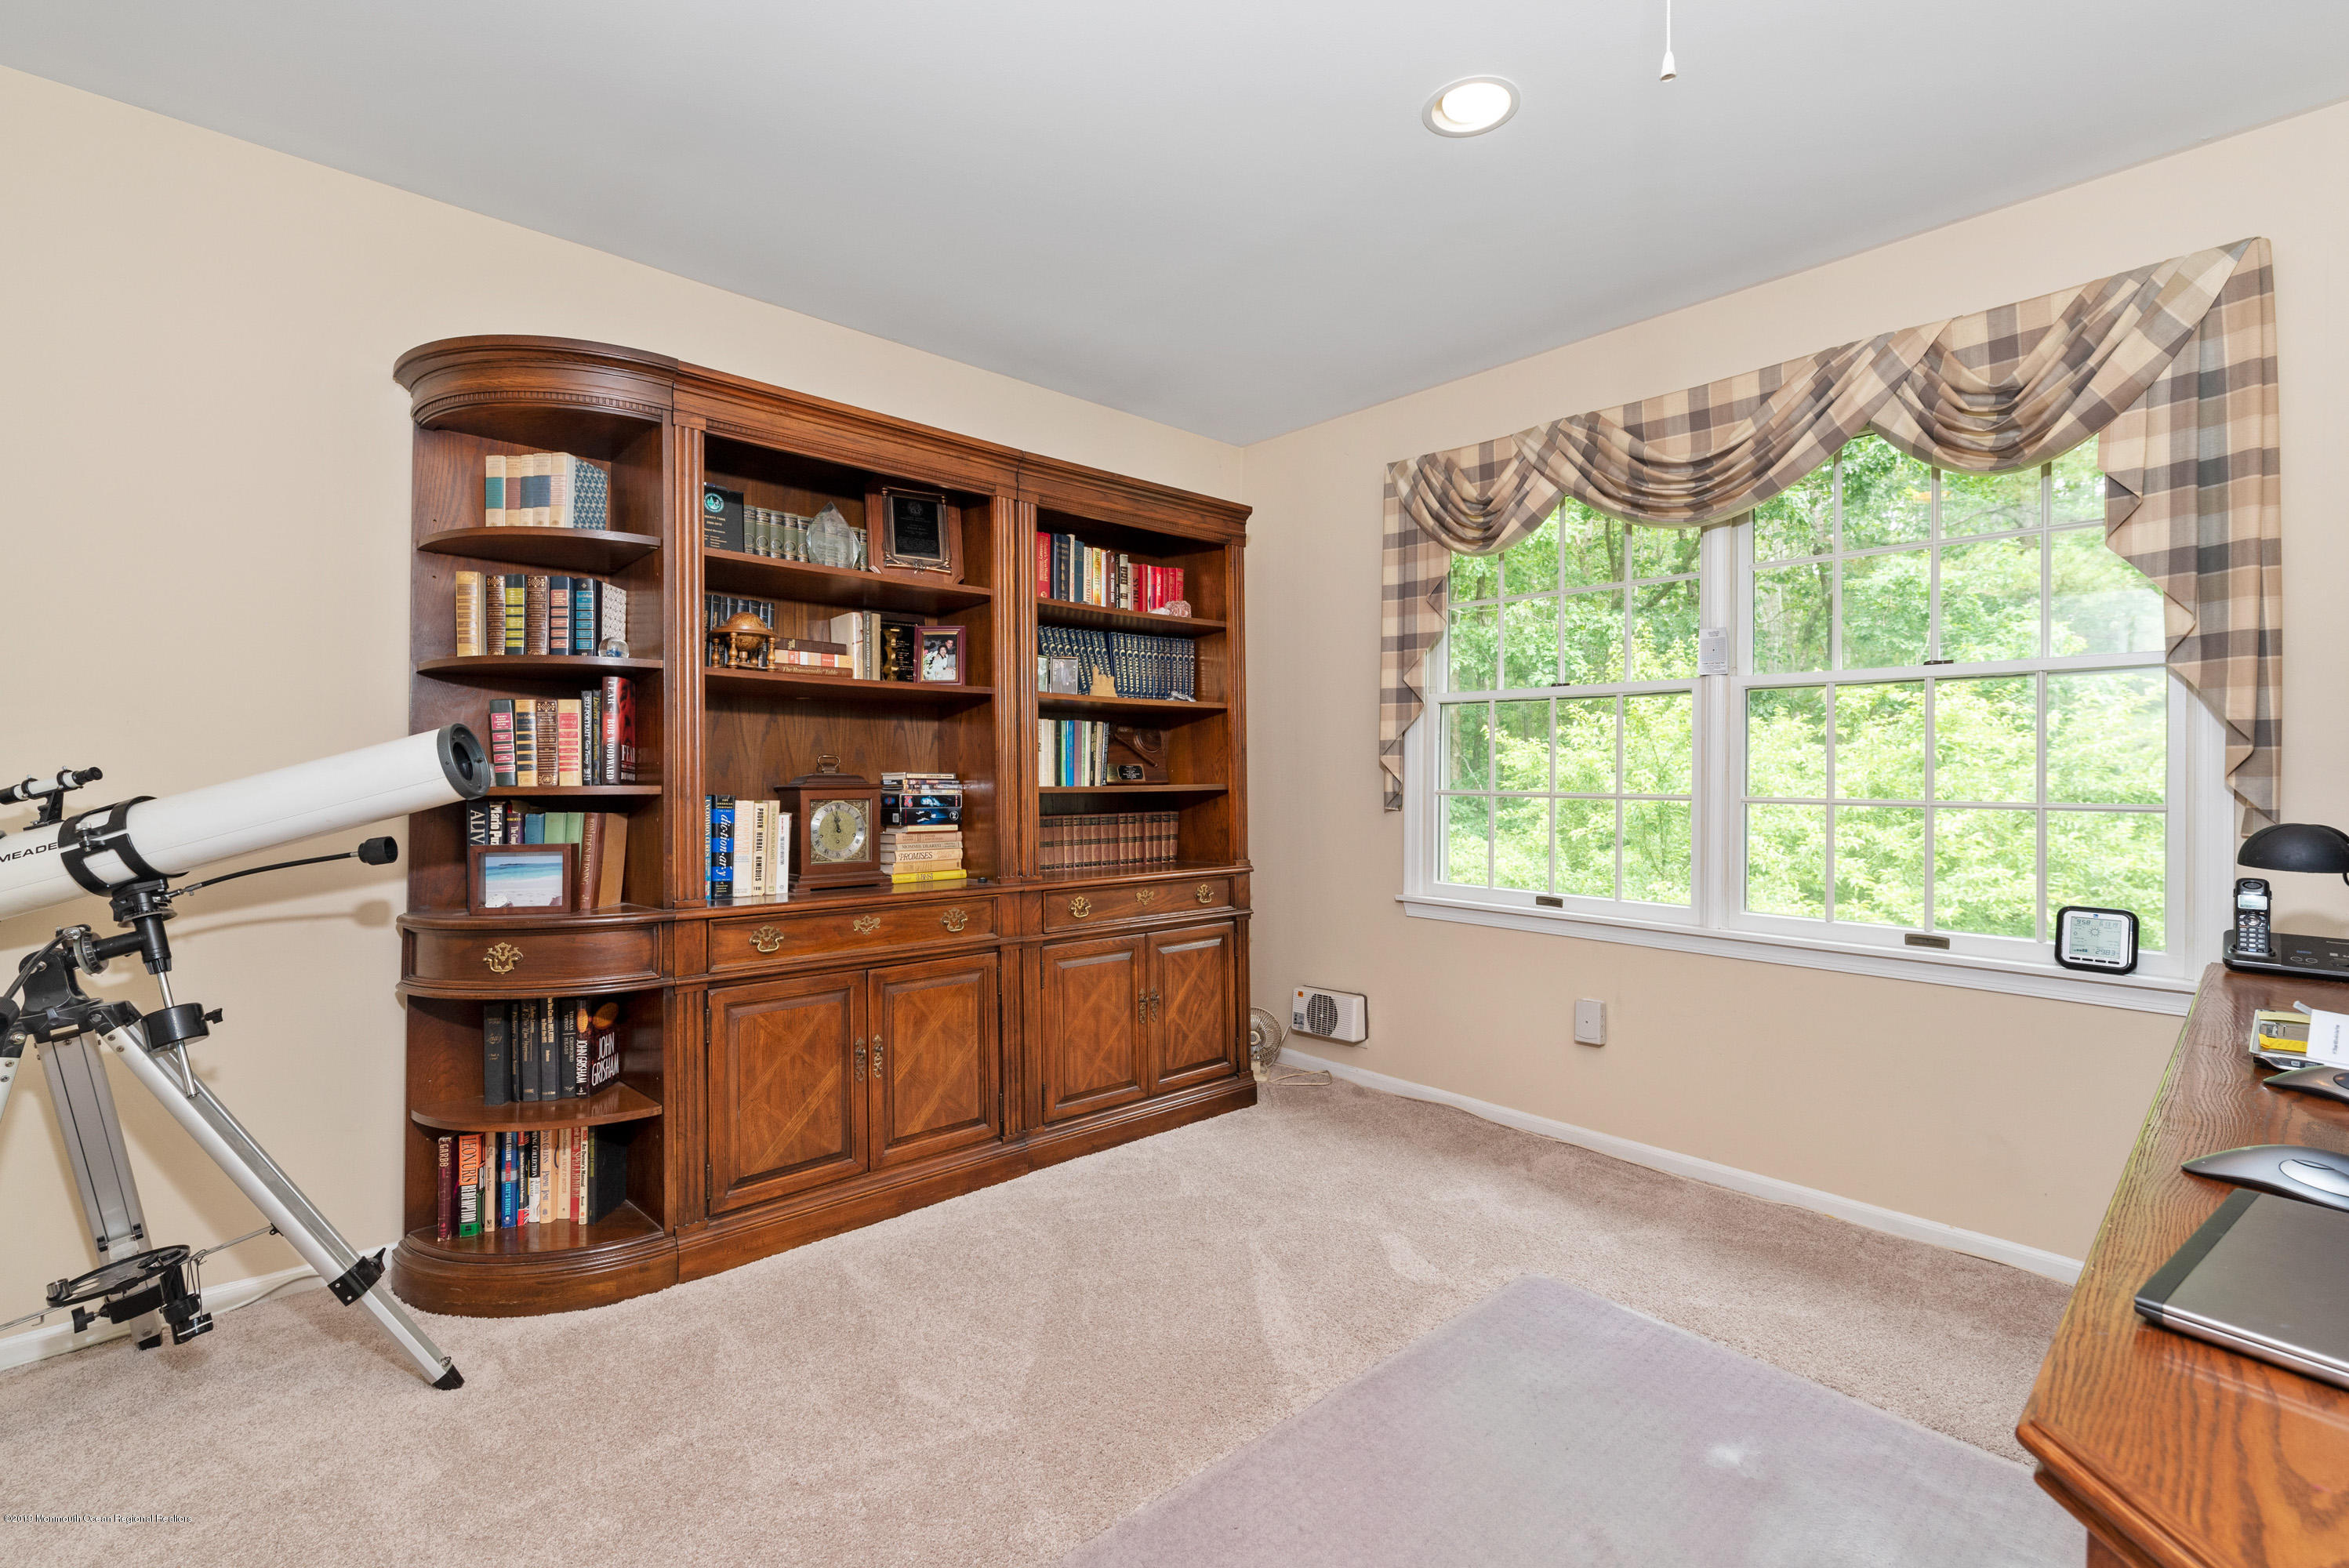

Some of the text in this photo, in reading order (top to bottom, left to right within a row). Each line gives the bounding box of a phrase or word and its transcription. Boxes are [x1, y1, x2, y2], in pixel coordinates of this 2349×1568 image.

[606, 737, 615, 780] WOODWARD
[470, 809, 485, 846] ALIV
[489, 805, 503, 846] Mario Puz
[0, 842, 57, 862] MEADE
[582, 834, 593, 885] EDEN BURNING
[899, 851, 933, 861] PROMISES
[575, 1040, 587, 1083] JOHN GRISHAM
[597, 1032, 615, 1061] JOHN
[591, 1052, 619, 1087] GRISHAM
[461, 1138, 477, 1222] LEON URIS REDEMPTION
[542, 1171, 551, 1187] PRIME
[542, 1189, 551, 1201] TIME
